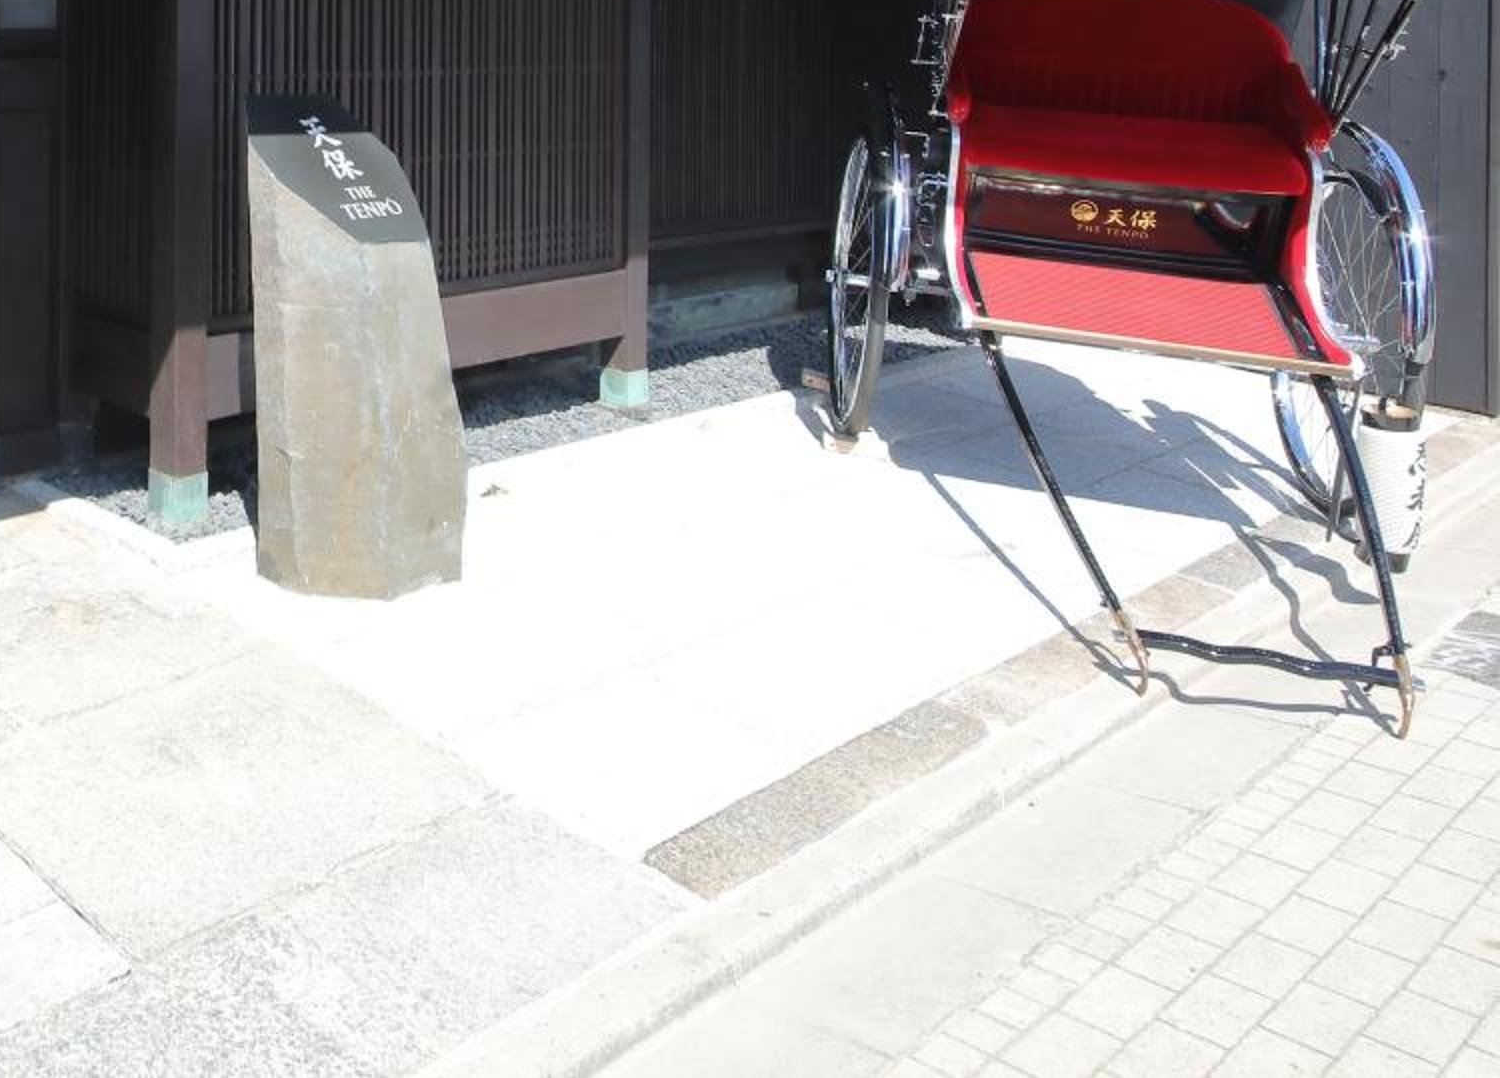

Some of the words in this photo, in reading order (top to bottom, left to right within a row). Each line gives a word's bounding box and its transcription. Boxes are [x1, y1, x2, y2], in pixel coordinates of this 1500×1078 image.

[299, 116, 364, 180] 天保
[343, 185, 377, 200] THE
[1103, 209, 1157, 230] 天保
[1076, 224, 1100, 234] THE
